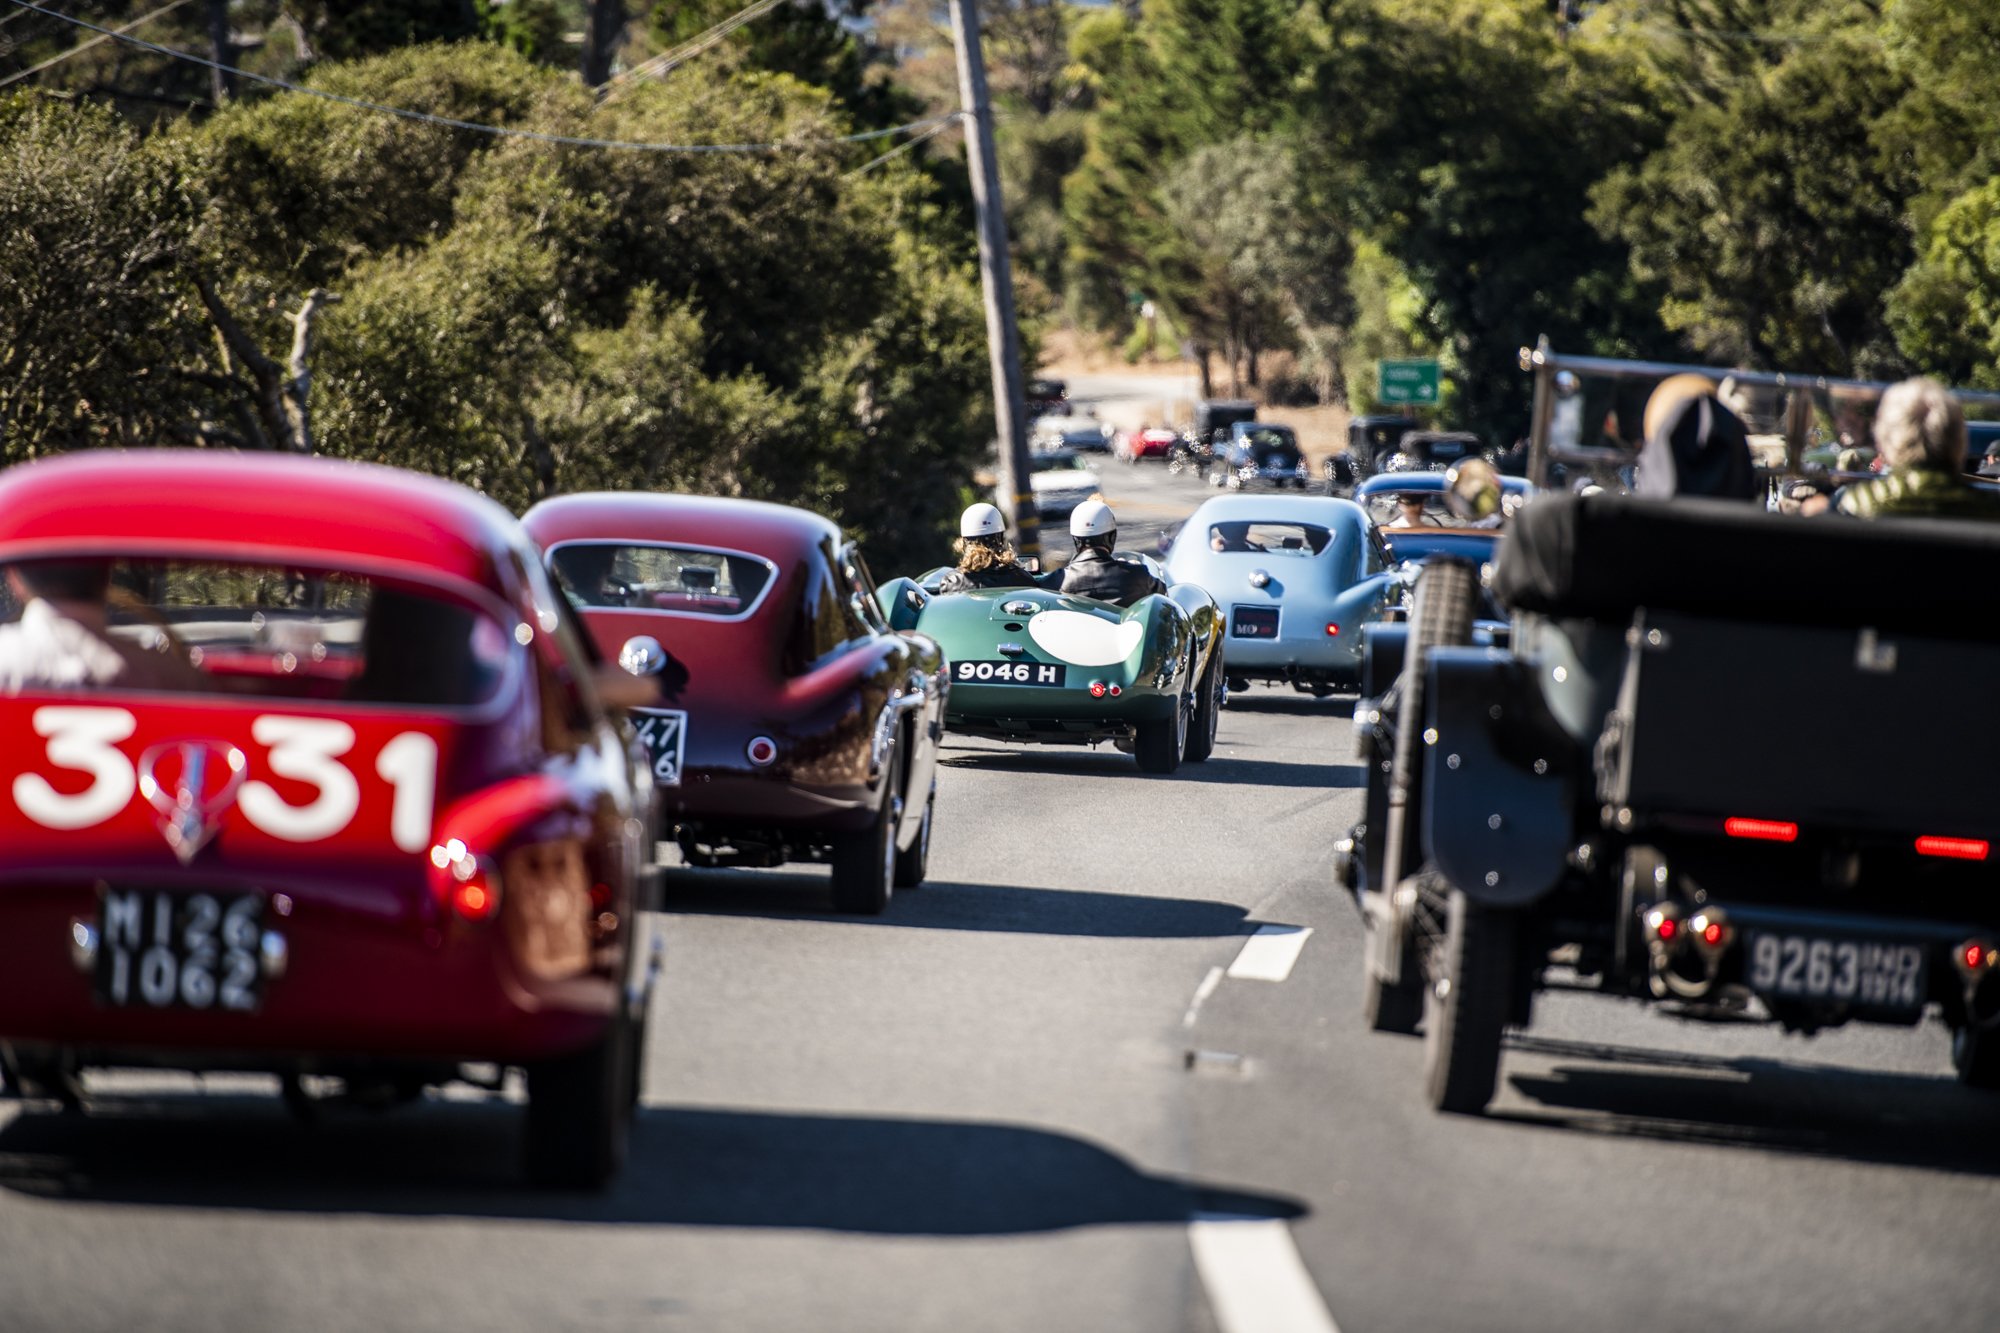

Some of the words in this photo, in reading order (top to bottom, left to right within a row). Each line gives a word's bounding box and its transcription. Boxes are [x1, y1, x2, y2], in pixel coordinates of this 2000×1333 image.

[958, 662, 1030, 682] 9046
[1037, 665, 1056, 683] H
[111, 946, 258, 1009] 1062
[1752, 935, 1859, 996] 9263
